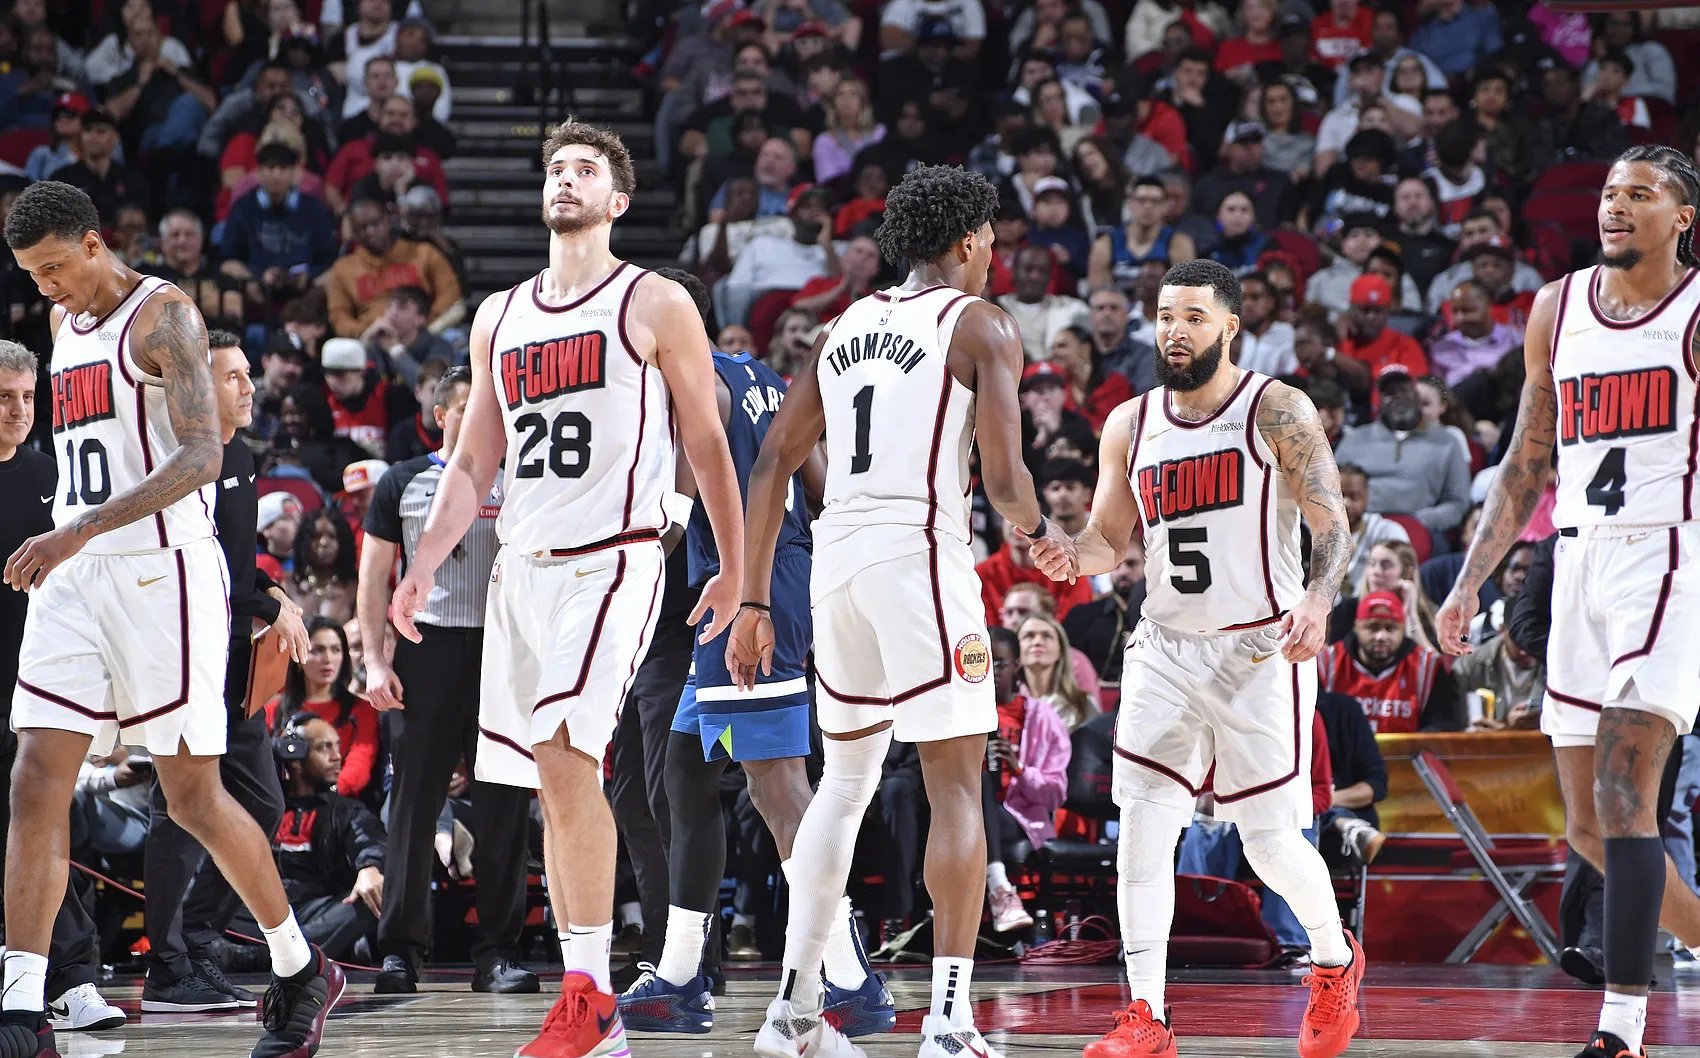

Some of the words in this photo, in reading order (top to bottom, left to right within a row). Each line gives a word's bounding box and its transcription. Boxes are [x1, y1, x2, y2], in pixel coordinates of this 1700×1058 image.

[826, 332, 926, 376] THOMPSON
[514, 411, 592, 478] 28
[851, 385, 874, 474] 1
[66, 438, 111, 505] 10
[1586, 447, 1627, 516] 4
[1168, 527, 1212, 594] 5
[1355, 697, 1412, 718] CKETS
